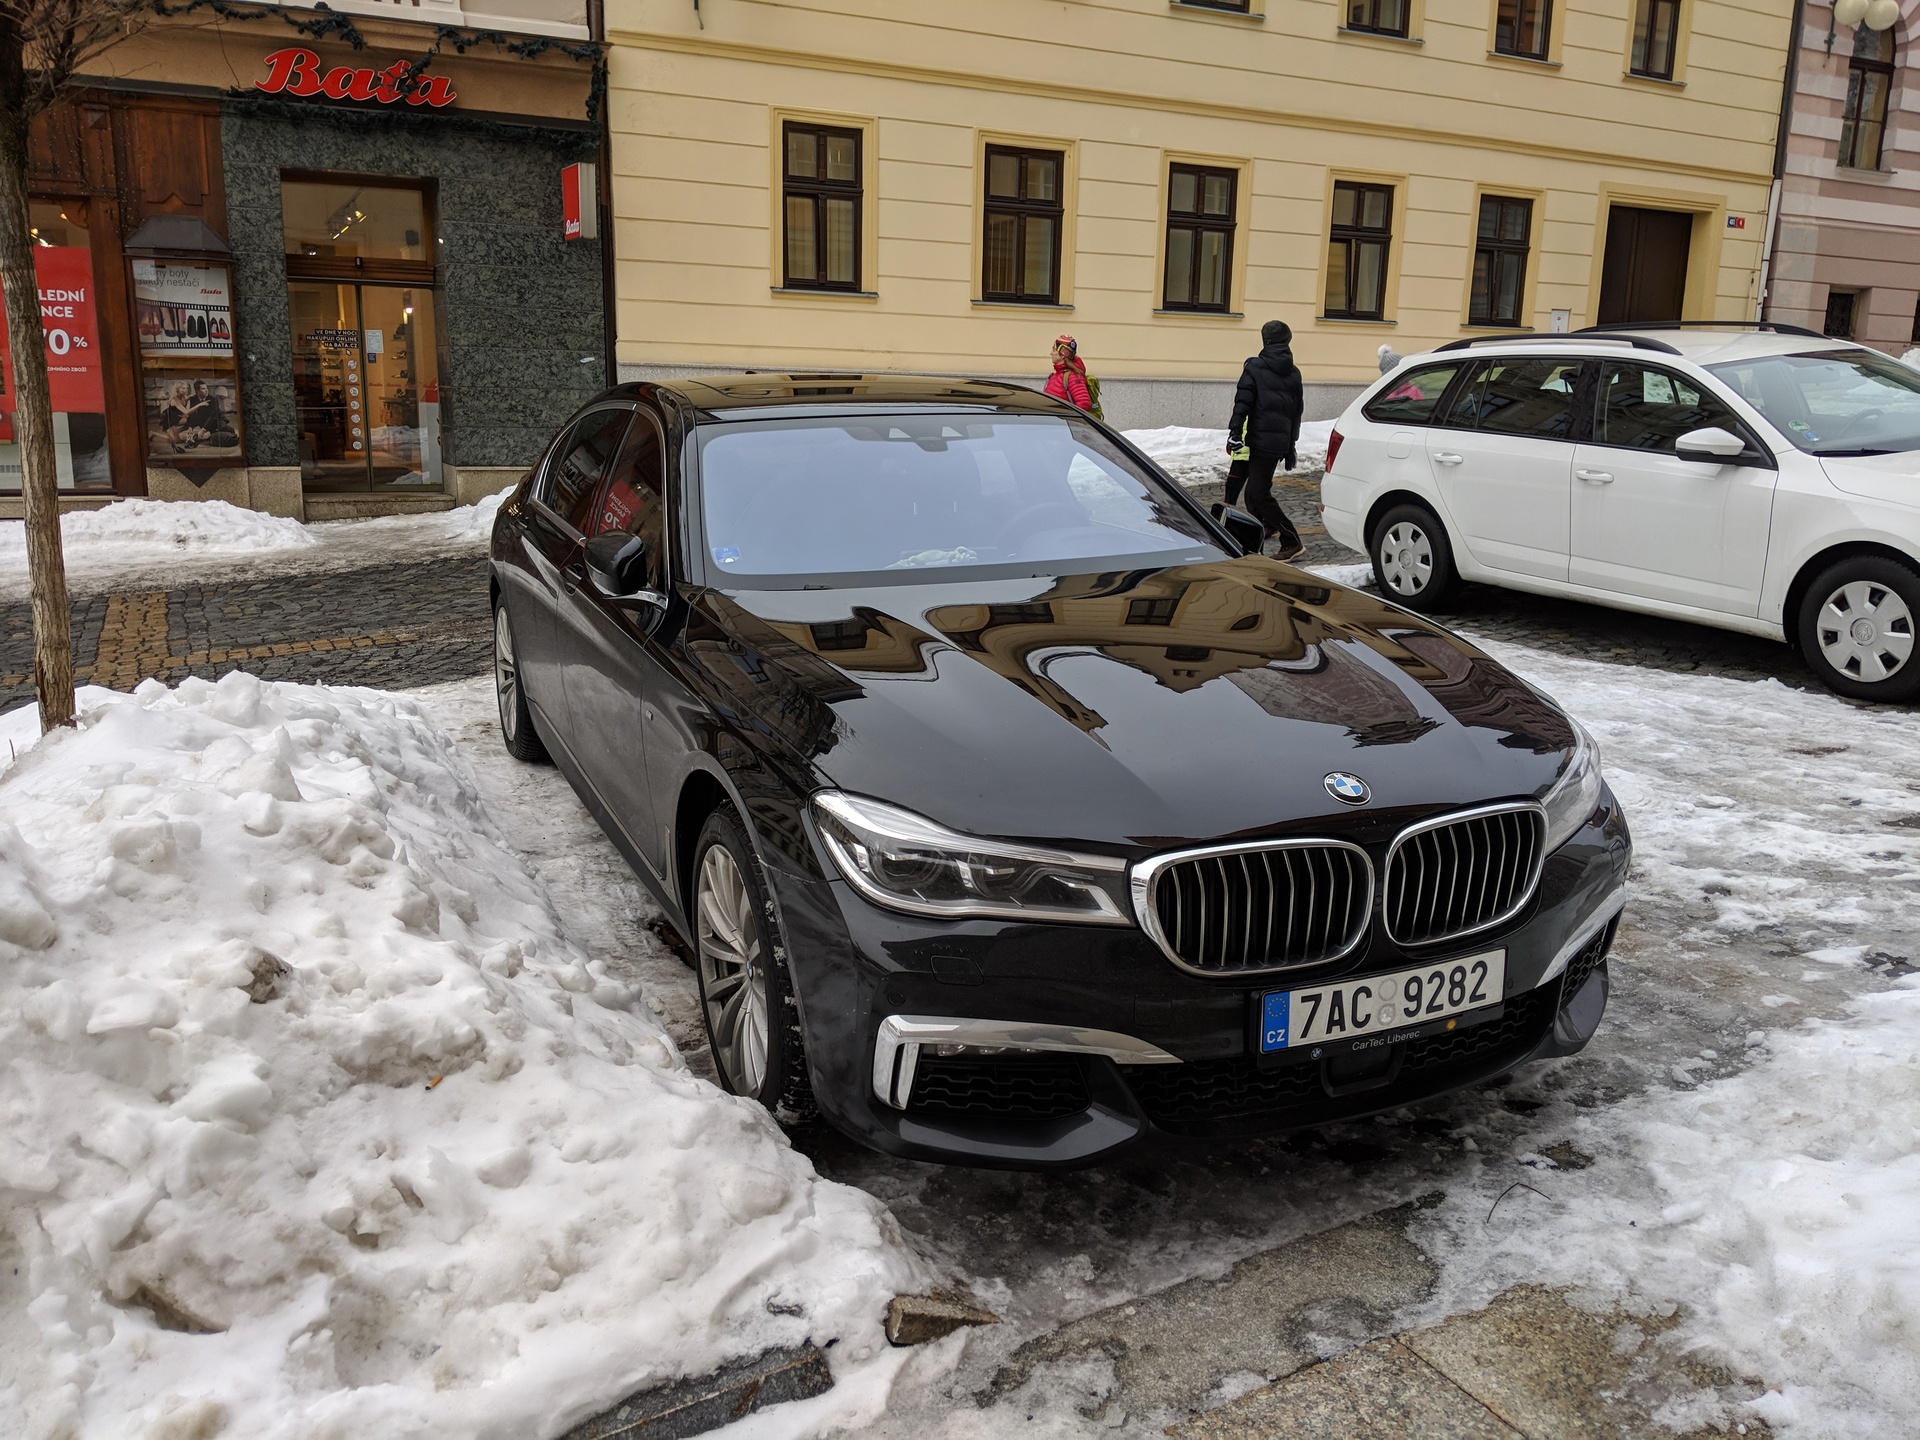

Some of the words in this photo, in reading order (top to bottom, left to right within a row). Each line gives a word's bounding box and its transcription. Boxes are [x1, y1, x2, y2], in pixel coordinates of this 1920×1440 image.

[566, 219, 580, 234] Bata
[169, 268, 189, 279] boty
[38, 288, 84, 302] LEDNÍ
[41, 306, 74, 318] NCE
[1300, 986, 1372, 1040] 7AC
[1403, 960, 1488, 1018] 9282
[1266, 1029, 1286, 1044] CZ
[1352, 1037, 1384, 1051] CarTec
[1387, 1030, 1420, 1044] Liberec
